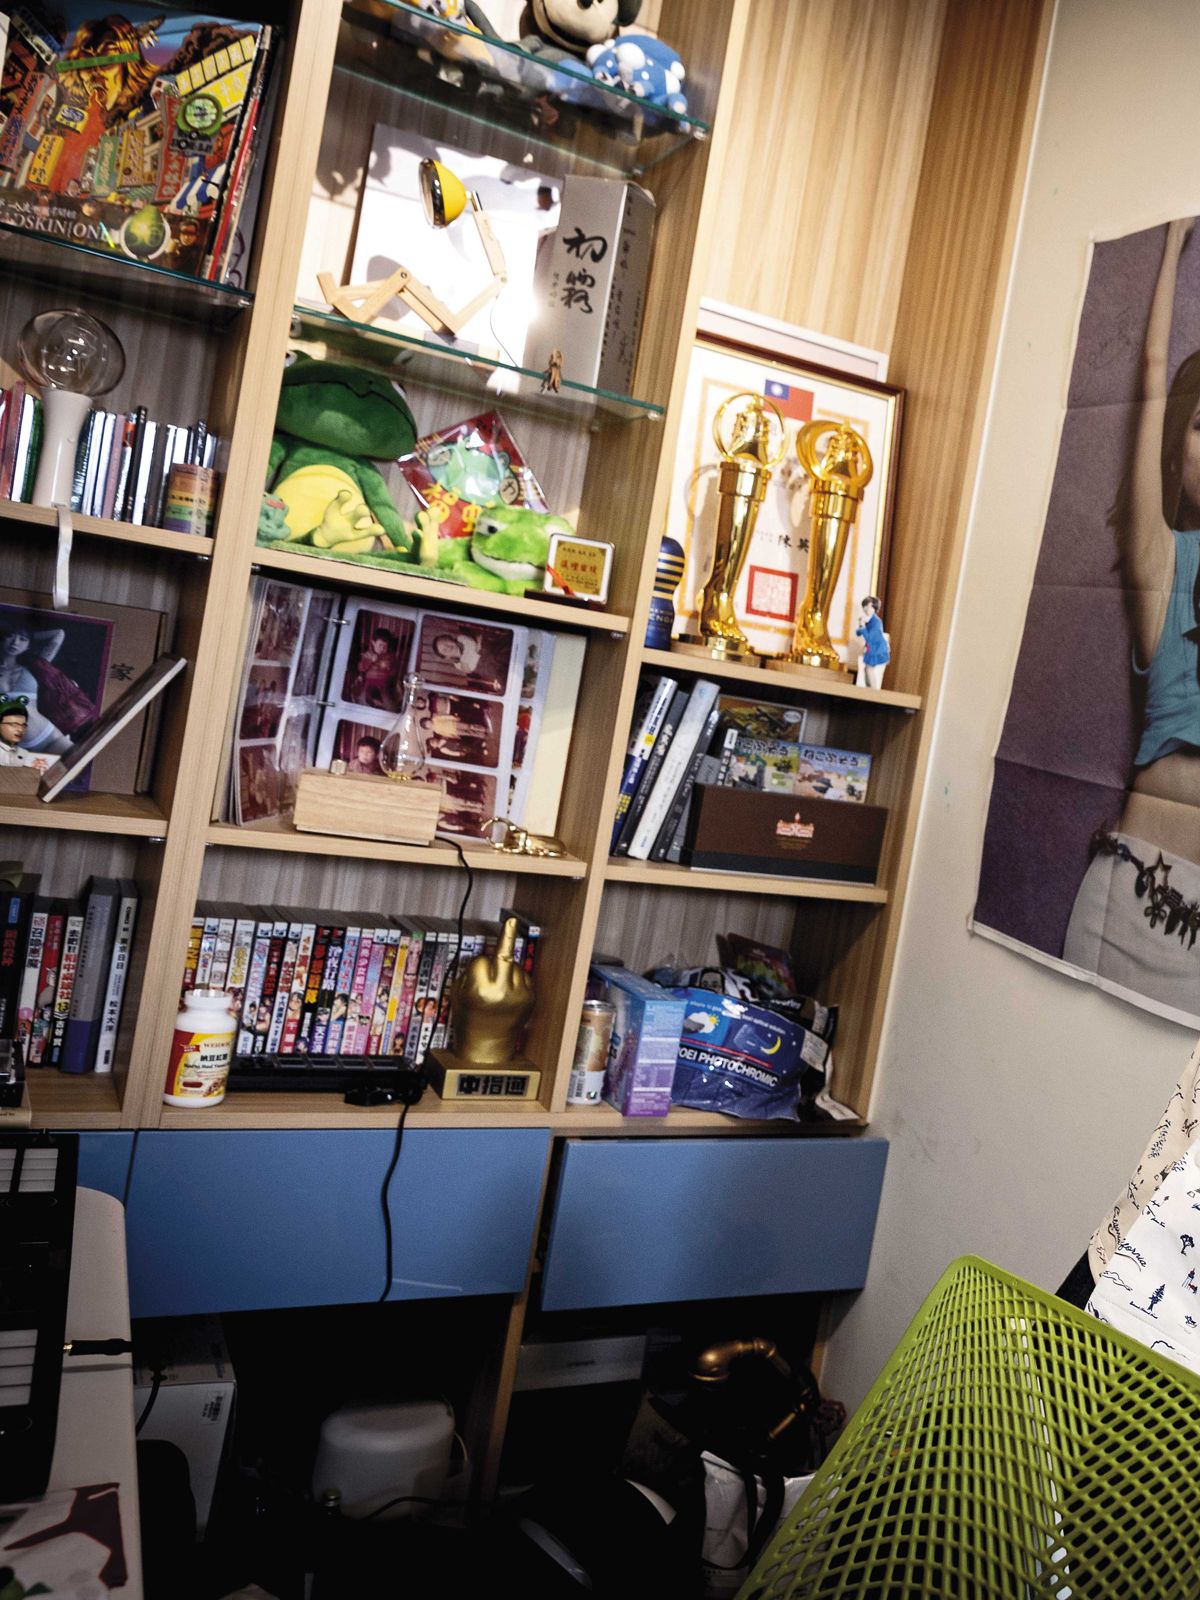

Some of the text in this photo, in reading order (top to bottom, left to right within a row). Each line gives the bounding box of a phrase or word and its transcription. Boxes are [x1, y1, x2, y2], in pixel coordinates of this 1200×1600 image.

[110, 663, 135, 681] 家
[679, 1047, 778, 1087] OEI PHOTOCHROMIC
